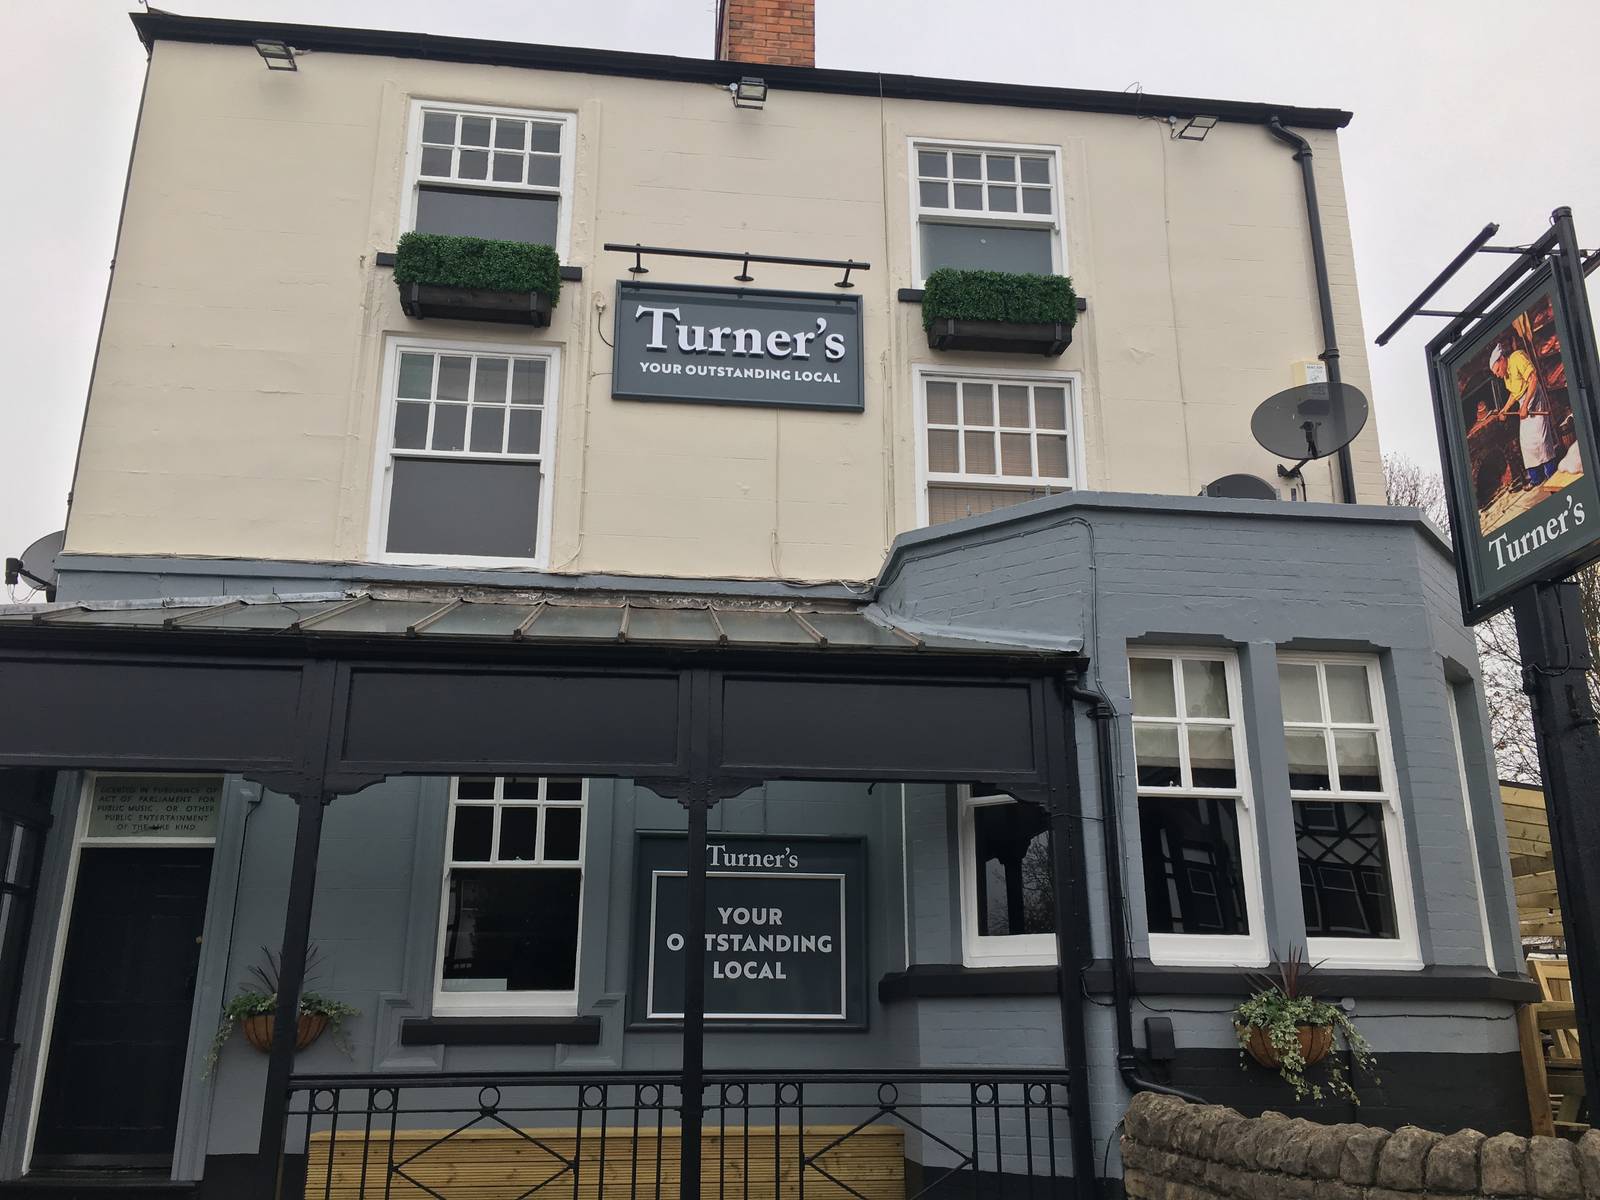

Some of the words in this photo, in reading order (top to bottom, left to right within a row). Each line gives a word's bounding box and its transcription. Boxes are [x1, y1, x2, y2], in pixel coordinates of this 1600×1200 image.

[635, 304, 846, 361] Turner's
[639, 361, 682, 375] YOUR
[685, 364, 791, 381] OUTSTANDING
[794, 371, 841, 384] LOCAL
[1488, 494, 1586, 571] Turner's
[120, 795, 132, 803] OF
[139, 795, 192, 803] PARLIAMENT
[138, 814, 209, 822] ENTERTAINMENT
[706, 844, 799, 869] Turner's
[718, 907, 783, 925] YOUR
[666, 933, 832, 953] OTSTANDING
[713, 961, 787, 979] LOCAL
